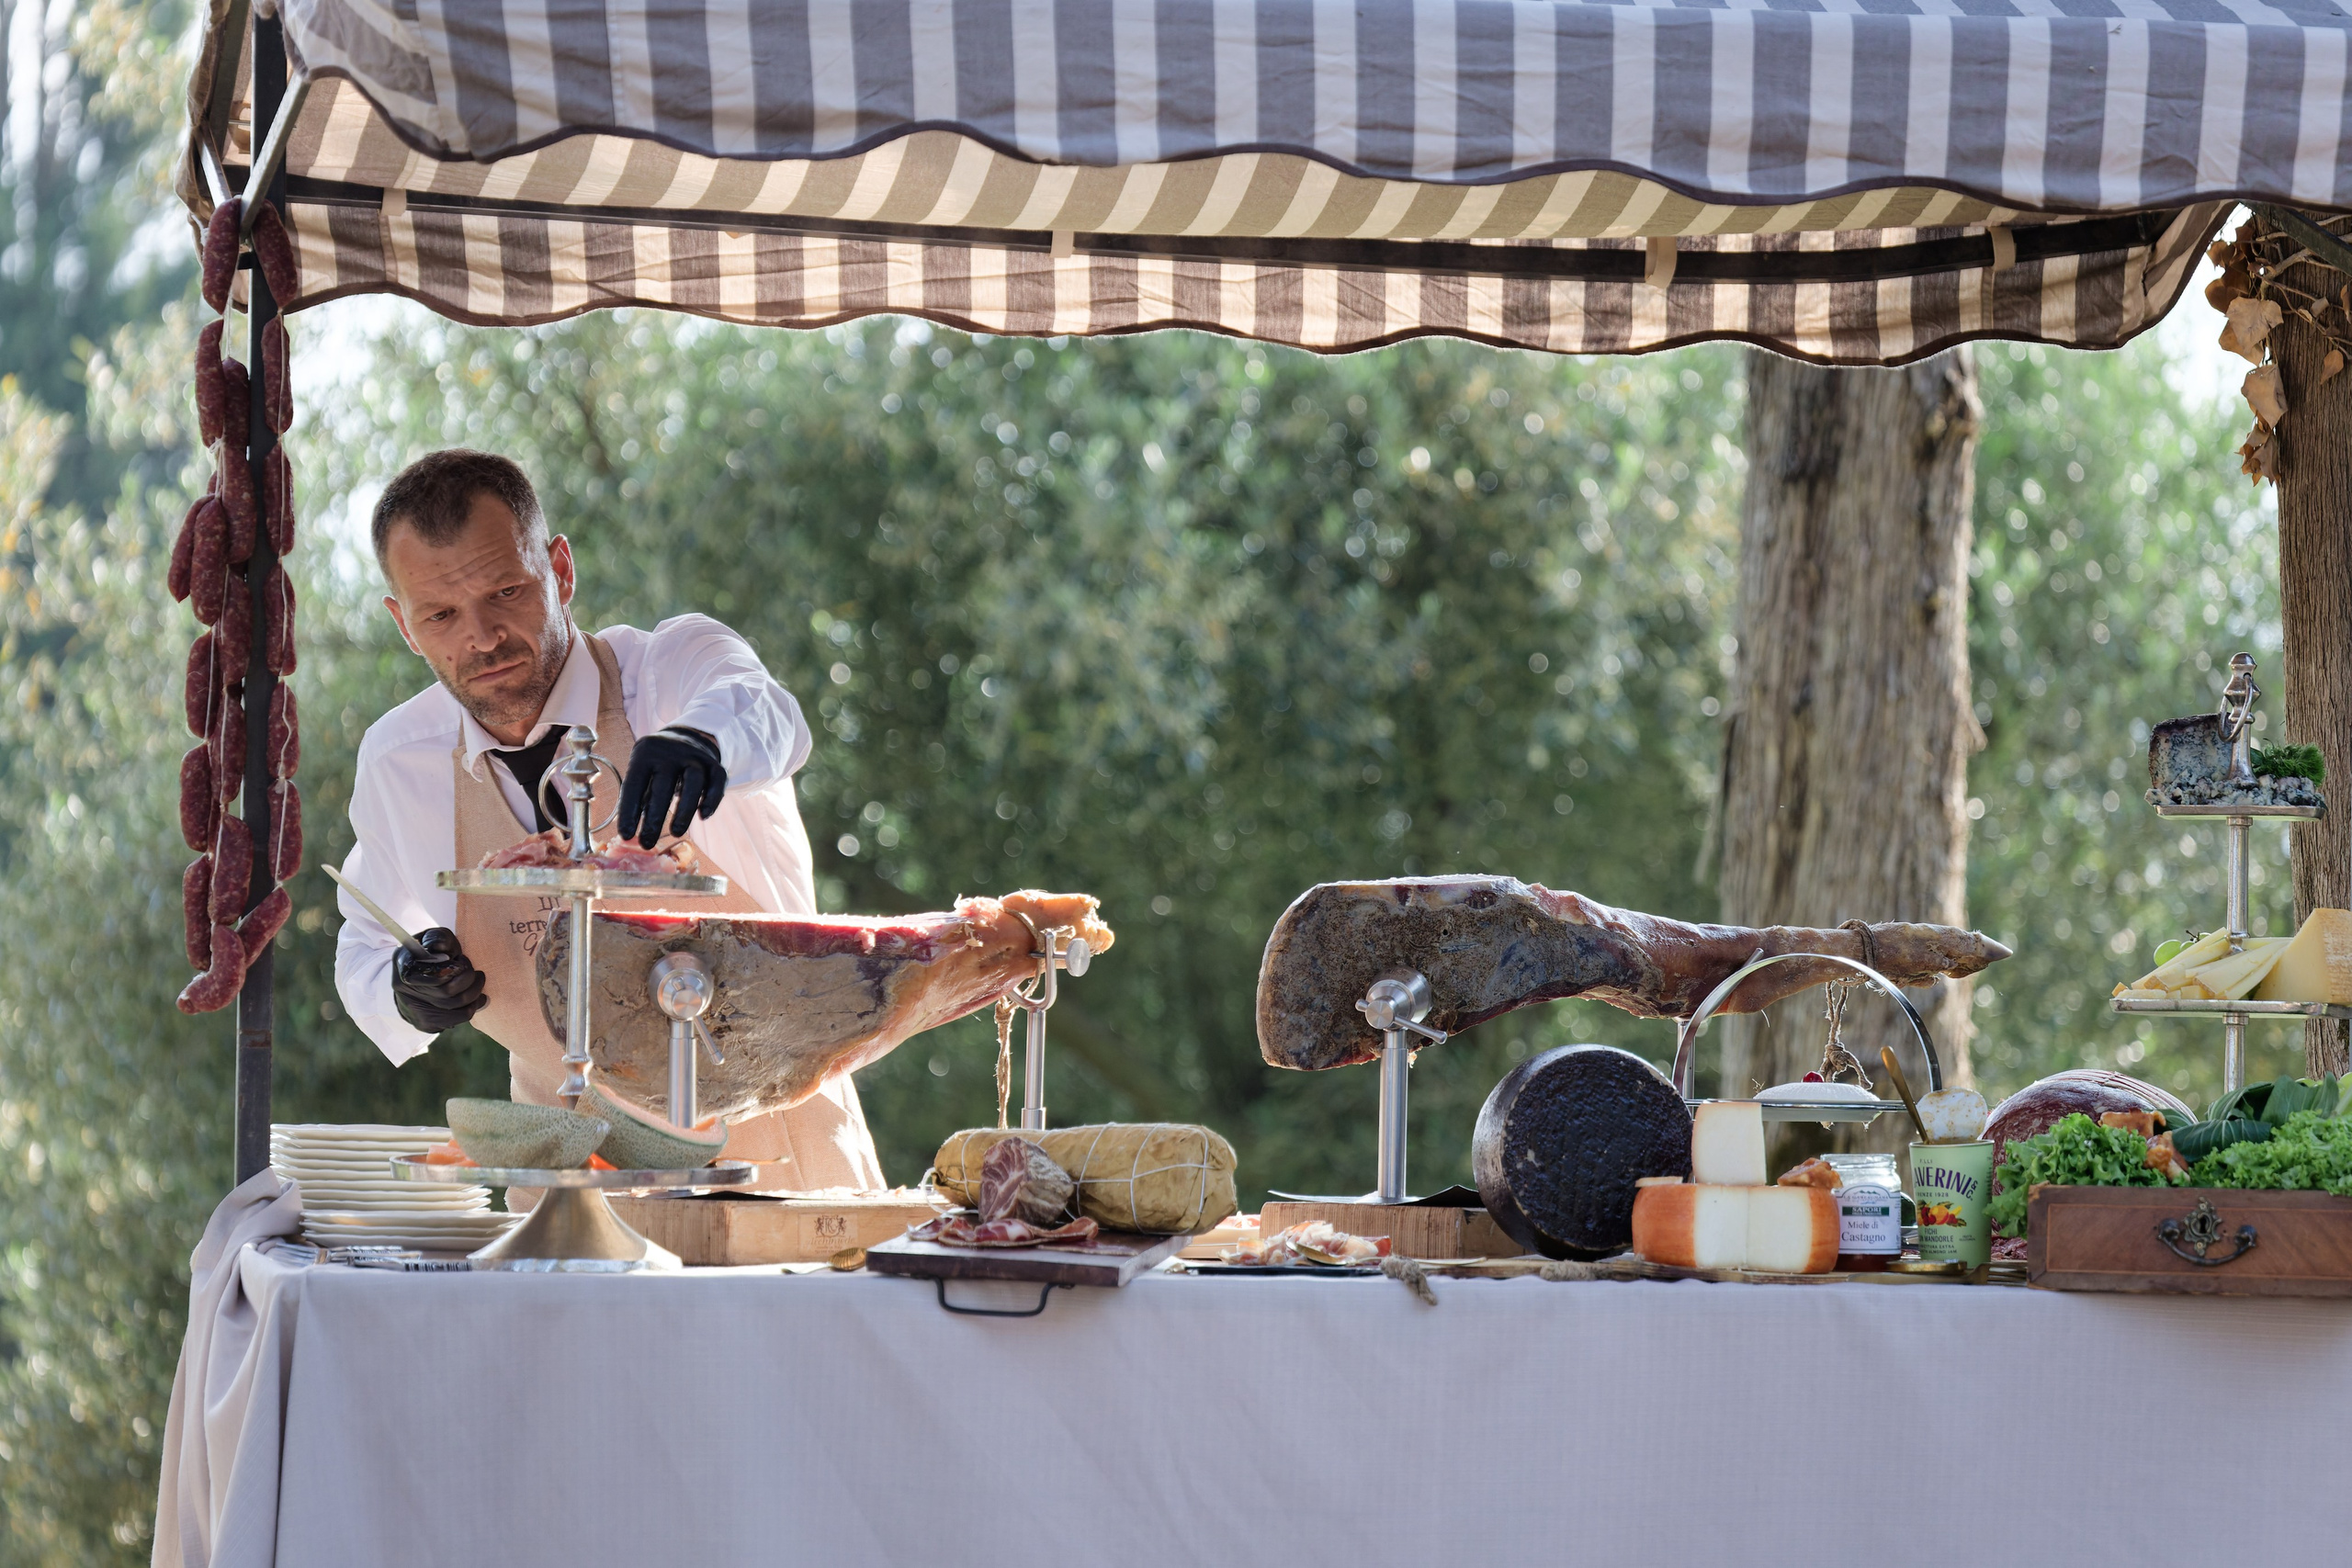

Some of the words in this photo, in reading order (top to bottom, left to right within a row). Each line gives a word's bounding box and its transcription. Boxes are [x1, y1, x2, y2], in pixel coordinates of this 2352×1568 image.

[1848, 1221, 1870, 1229] Miele
[1871, 1221, 1879, 1229] di
[1841, 1232, 1886, 1245] Castagno
